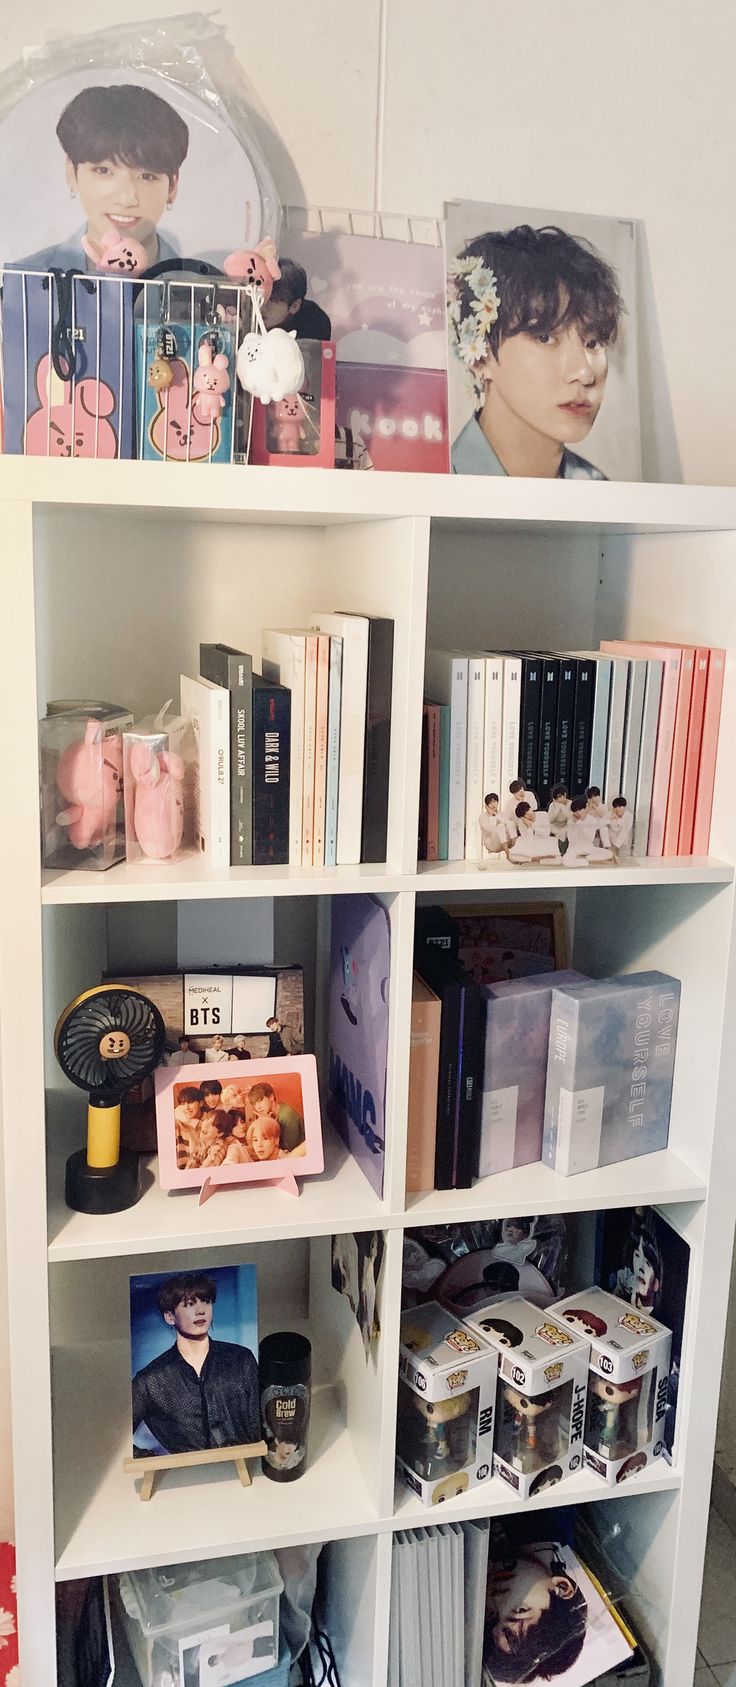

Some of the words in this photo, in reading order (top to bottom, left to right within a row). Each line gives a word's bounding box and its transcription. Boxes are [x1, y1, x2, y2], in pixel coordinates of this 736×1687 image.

[165, 333, 175, 356] BT21
[350, 409, 443, 441] kook
[237, 708, 246, 732] SKOOL
[237, 734, 246, 748] LUV
[264, 732, 279, 753] DARK
[236, 749, 246, 777] AFFAIR
[264, 763, 279, 784] WILD
[188, 986, 222, 994] MEDIHEAL
[190, 1007, 221, 1026] BTS
[655, 992, 676, 1057] LOVE
[554, 1018, 569, 1065] EUROPE
[628, 996, 655, 1128] YOURSELF
[512, 1368, 525, 1384] 102
[599, 1357, 614, 1372] 103
[276, 1398, 297, 1410] Cold
[655, 1376, 668, 1423] SUGA
[276, 1409, 296, 1418] Brew
[478, 1406, 493, 1437] RM
[570, 1384, 586, 1444] J-HOPE
